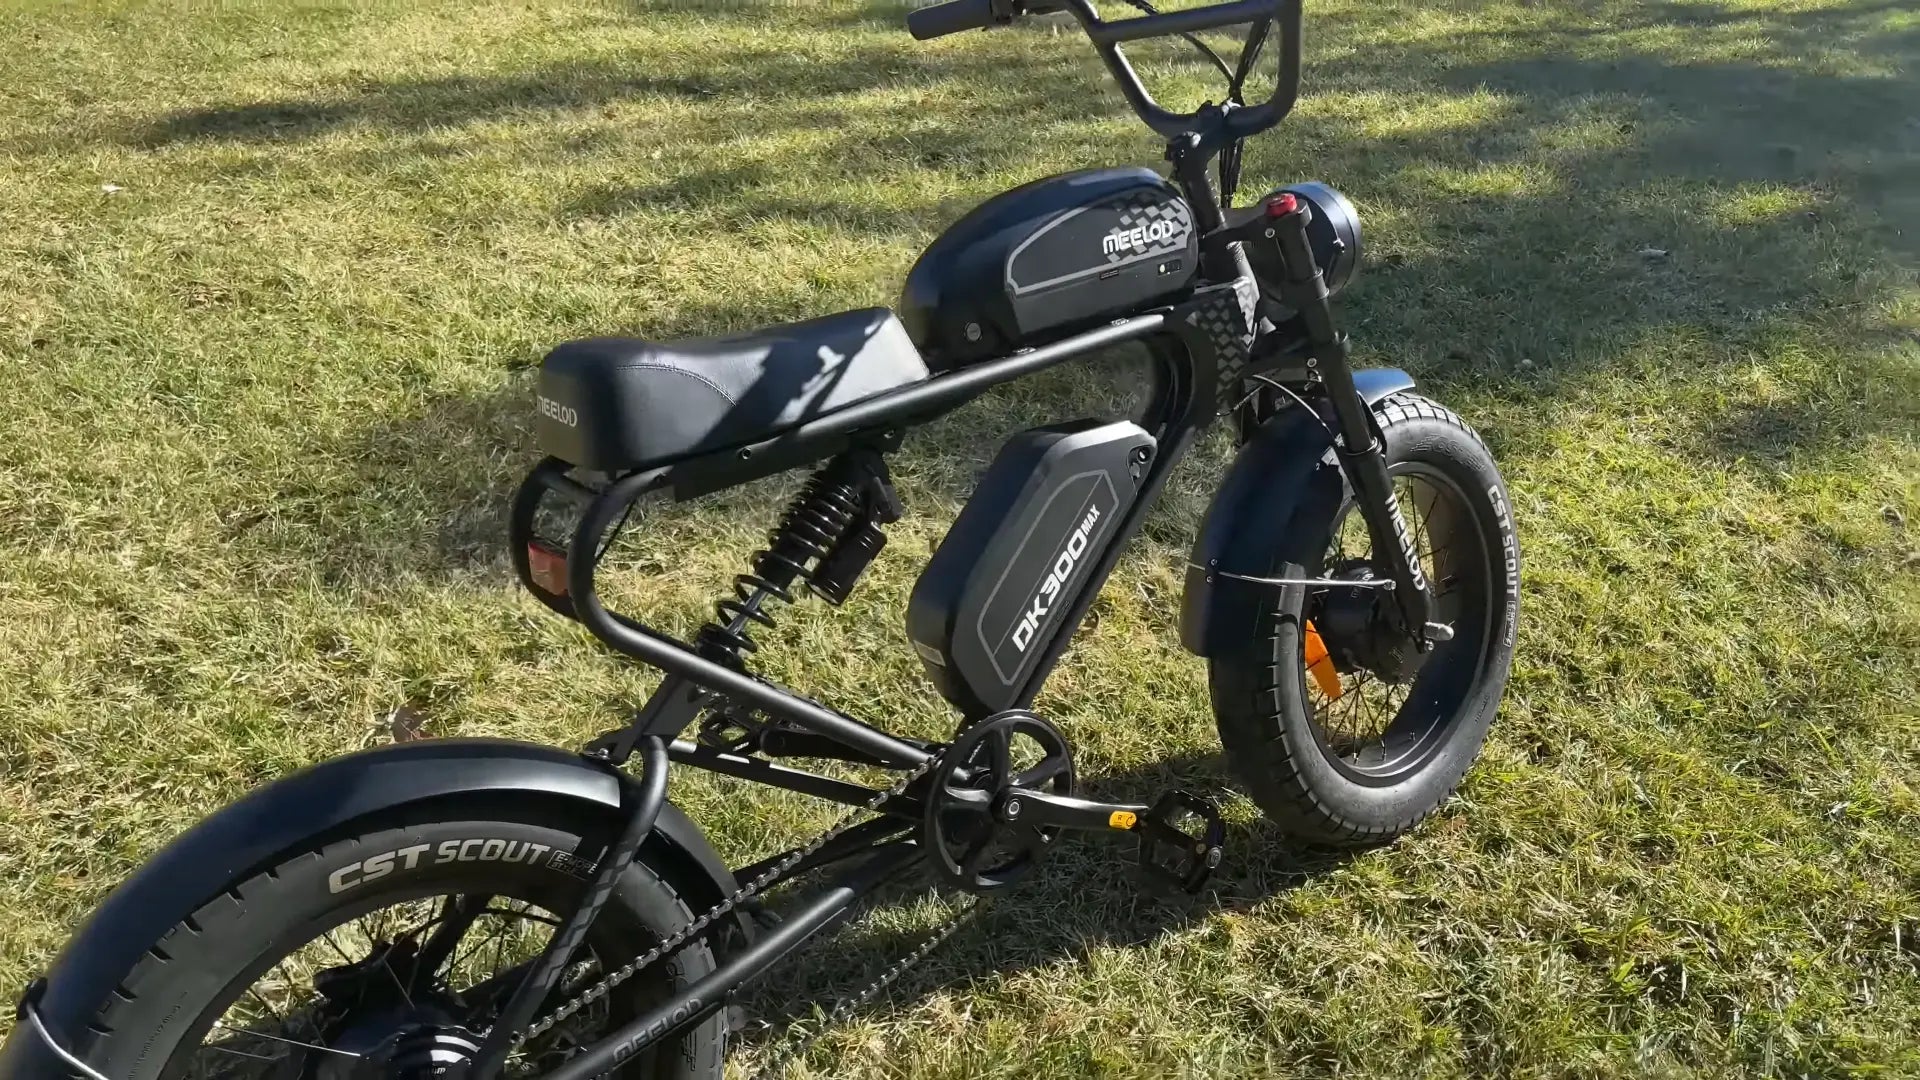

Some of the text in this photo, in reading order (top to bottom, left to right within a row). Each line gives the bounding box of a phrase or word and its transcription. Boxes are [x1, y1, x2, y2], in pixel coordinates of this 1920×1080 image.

[1103, 220, 1174, 254] MEELOD
[1080, 504, 1101, 536] MAX
[1385, 492, 1425, 591] MEELOD
[1487, 484, 1511, 531] CST
[1501, 534, 1517, 597] SCOUT
[329, 838, 550, 894] CST SCOUT
